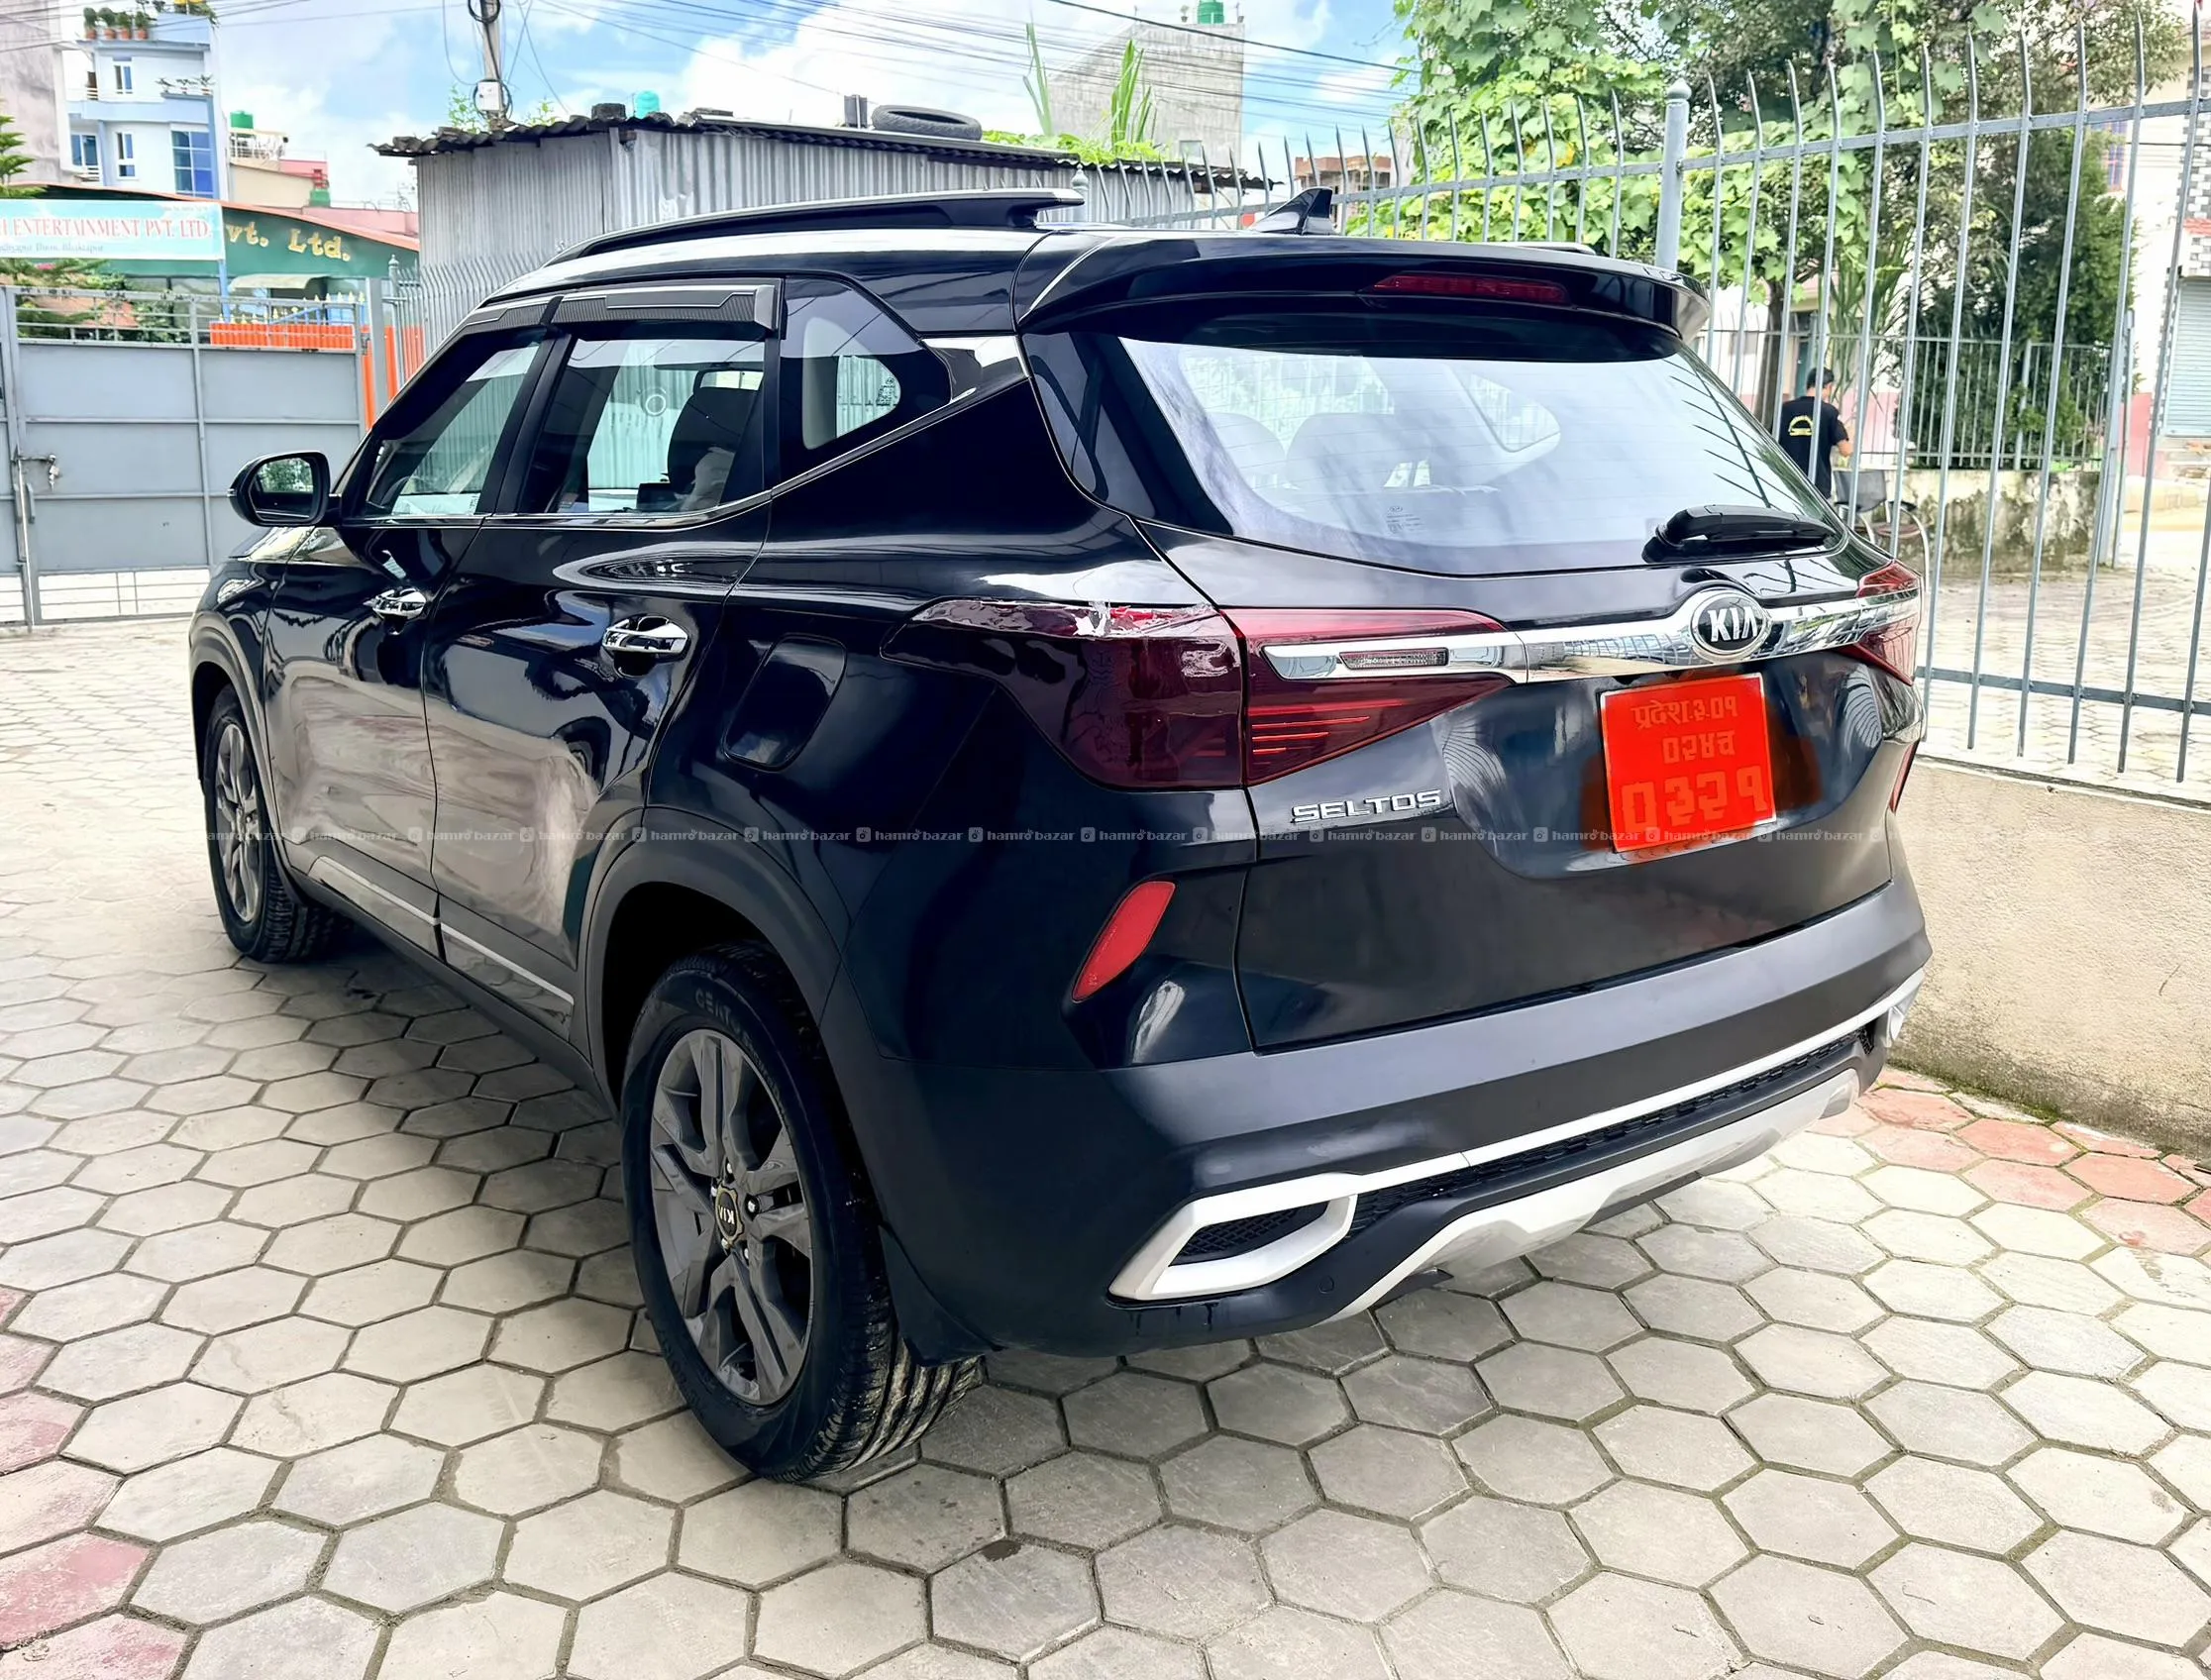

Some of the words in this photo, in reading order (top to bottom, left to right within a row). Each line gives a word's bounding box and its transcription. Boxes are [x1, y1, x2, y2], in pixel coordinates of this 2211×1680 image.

[13, 219, 140, 237] ENTERTAINMENT
[146, 219, 174, 237] PVT.
[180, 219, 212, 237] LTD.
[225, 221, 269, 247] vt.
[288, 228, 351, 262] Ltd.
[1707, 606, 1758, 643] KIA
[1292, 789, 1441, 823] SELTOS
[718, 1206, 735, 1225] KIA
